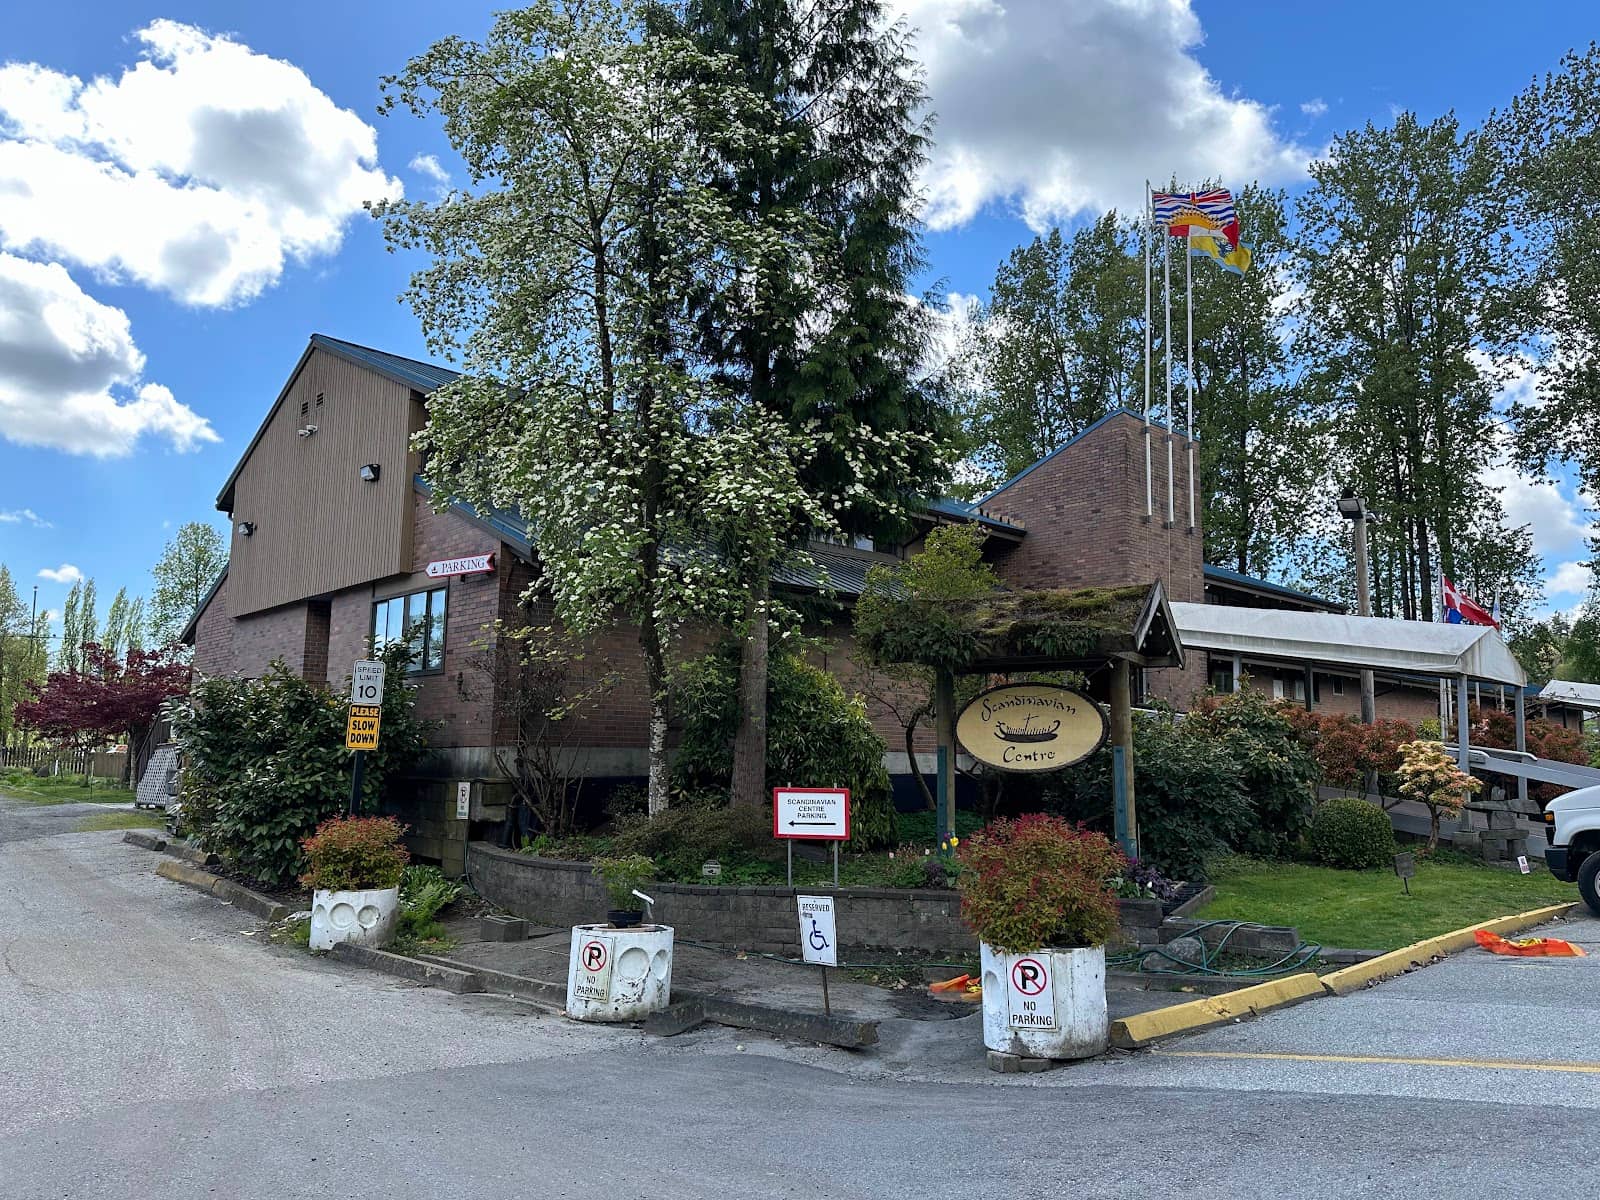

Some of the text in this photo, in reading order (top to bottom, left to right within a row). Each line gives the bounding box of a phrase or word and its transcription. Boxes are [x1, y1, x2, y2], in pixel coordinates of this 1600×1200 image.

[442, 558, 485, 573] PARKING
[357, 666, 382, 674] SPEED
[358, 685, 377, 698] 10
[351, 706, 380, 717] PLEASE
[981, 694, 1076, 721] Scandinavian
[352, 720, 376, 731] SLOW
[350, 733, 375, 744] DOWN
[1003, 746, 1056, 763] Centre
[802, 903, 830, 912] RESERVED
[587, 975, 596, 984] NO
[576, 985, 605, 997] PARKING
[1023, 1001, 1036, 1011] NO
[1012, 1014, 1053, 1026] PARKING
